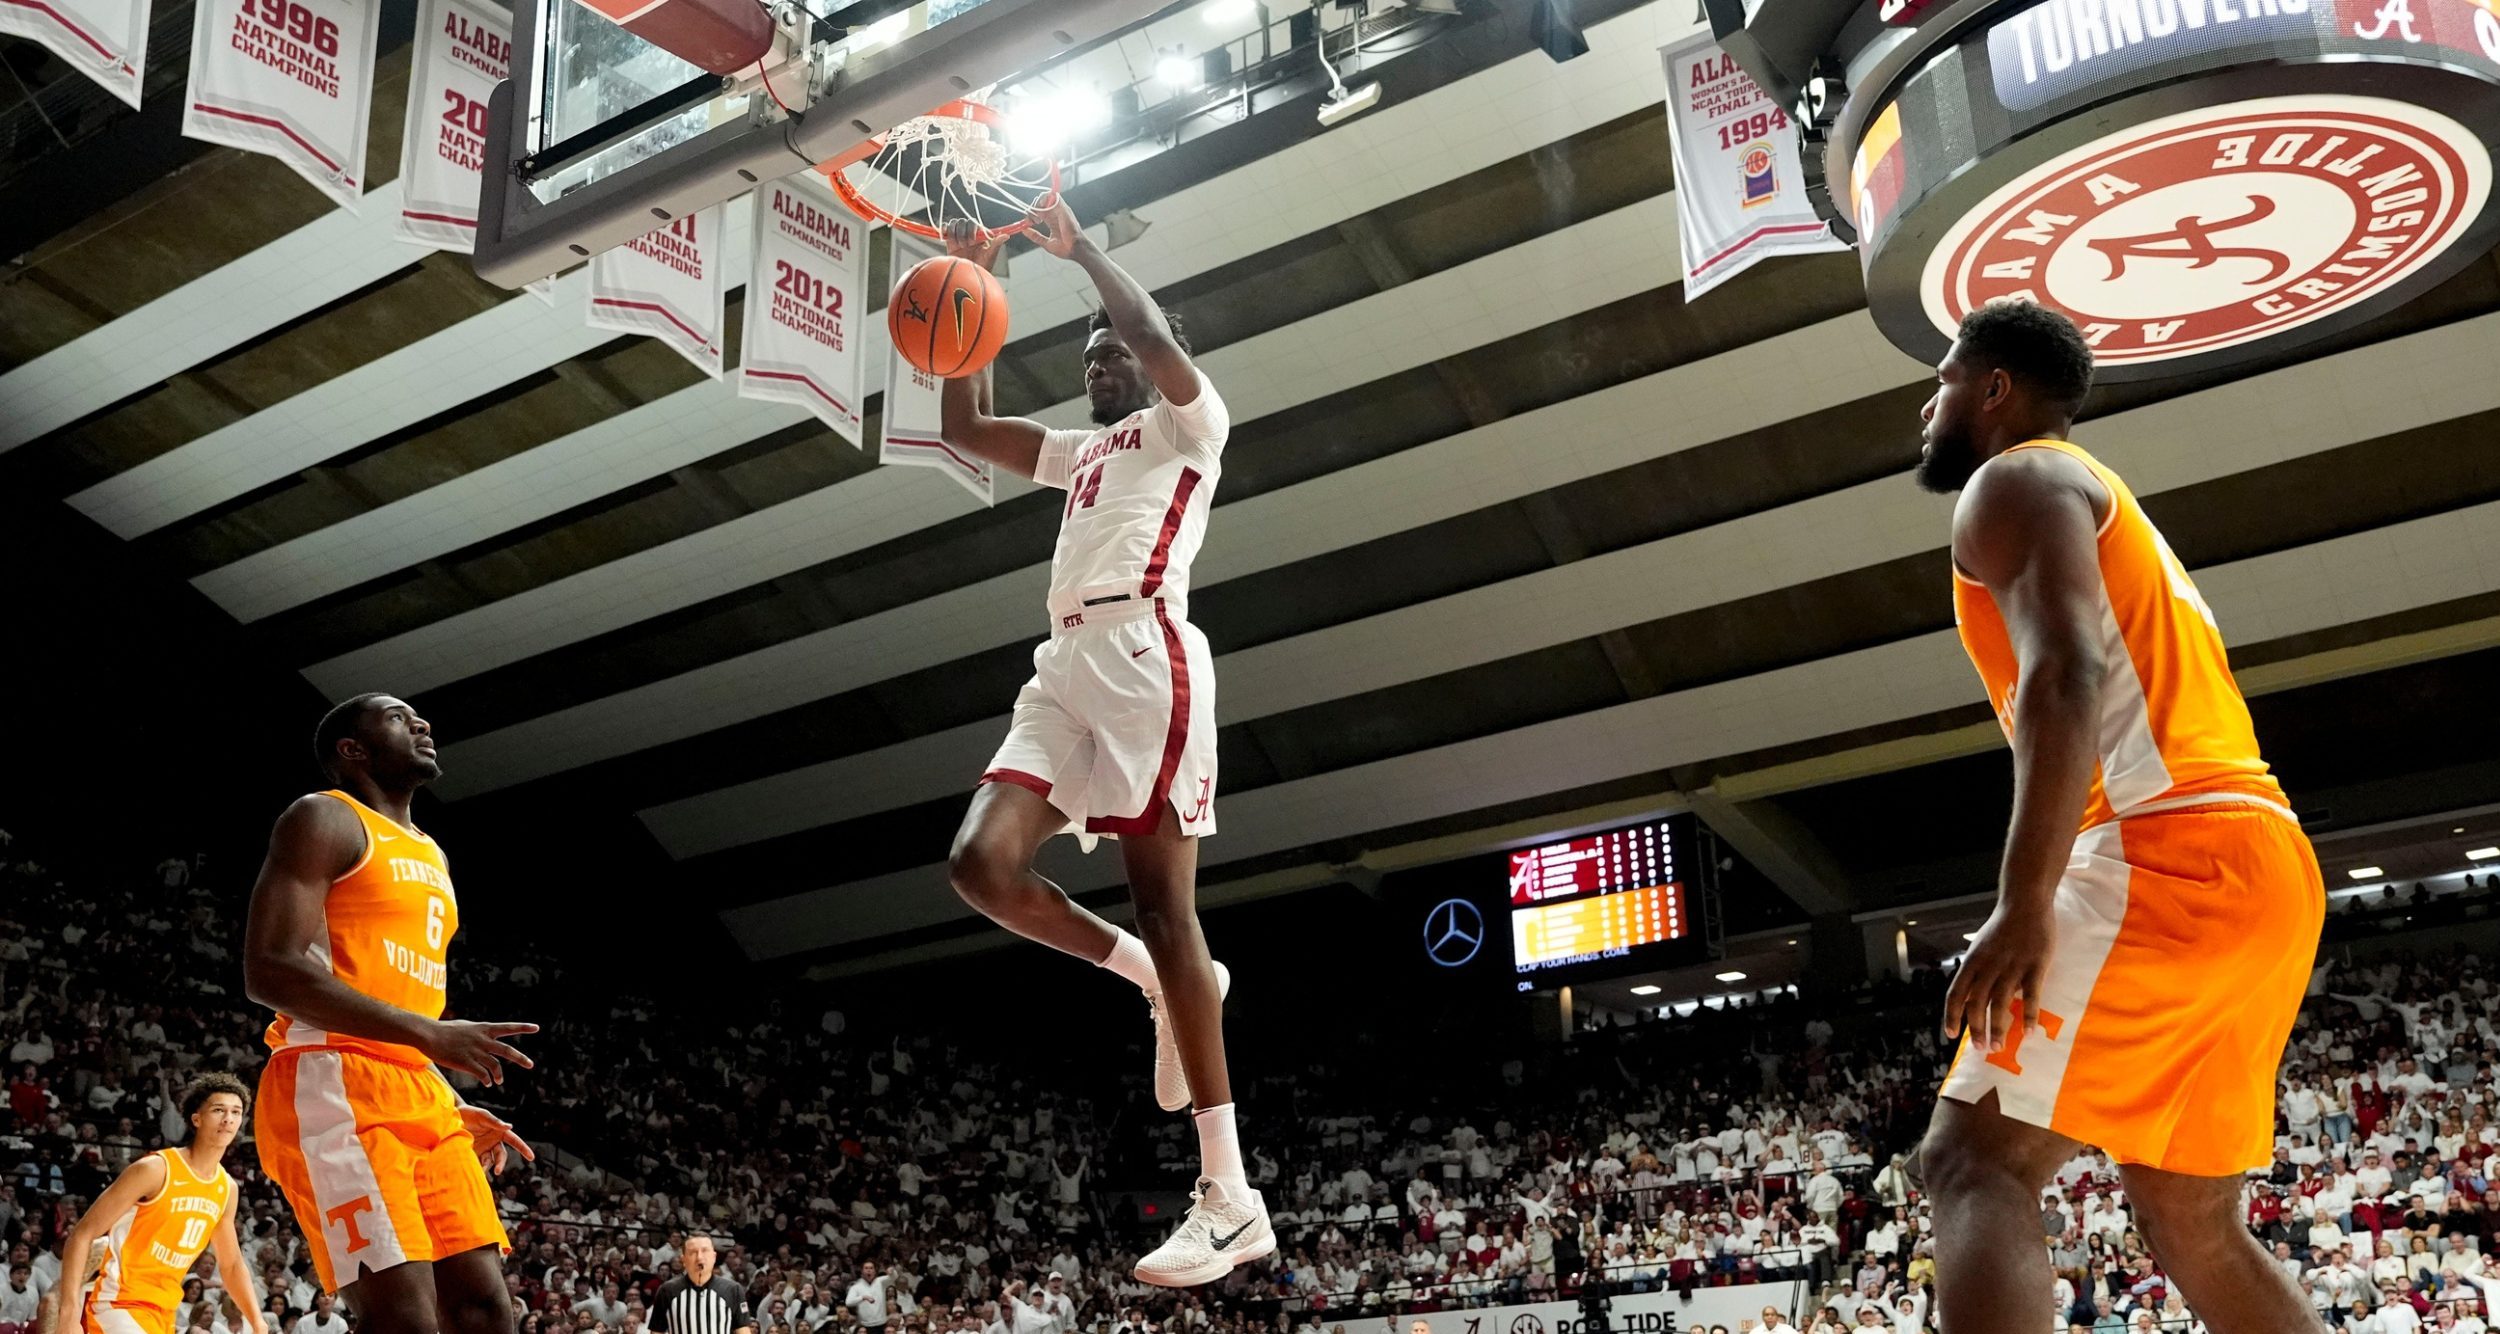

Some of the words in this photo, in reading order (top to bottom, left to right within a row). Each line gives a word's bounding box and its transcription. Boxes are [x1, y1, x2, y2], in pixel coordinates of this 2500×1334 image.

[231, 33, 339, 99] CHAMPIONS
[234, 13, 340, 82] NATIONAL
[452, 46, 510, 80] GYMNAS
[1691, 53, 1743, 88] ALA
[1691, 78, 1737, 101] WOMEN'S
[1691, 98, 1721, 112] NCAA
[1725, 82, 1758, 99] TOUR
[1708, 96, 1750, 119] FINAL
[1718, 107, 1787, 150] 1994
[2212, 134, 2386, 177] TIDE
[773, 189, 850, 251] ALABAMA
[780, 220, 843, 262] GYMNASTICS
[2252, 163, 2428, 316] CRIMSON
[624, 239, 702, 280] HAMPIONS
[1982, 173, 2186, 347] ALAMA
[775, 259, 843, 320] 2012
[772, 308, 843, 352] CHAMPIONS
[773, 291, 843, 338] NATIONAL
[912, 374, 935, 392] 2015
[1067, 463, 1105, 520] 14
[1063, 613, 1084, 629] RTR
[426, 896, 445, 950] 6
[1541, 958, 1566, 968] YOUR
[1602, 946, 1630, 958] COME
[178, 1217, 207, 1249] 10
[326, 1195, 373, 1255] T
[1623, 1311, 1677, 1331] TIDE
